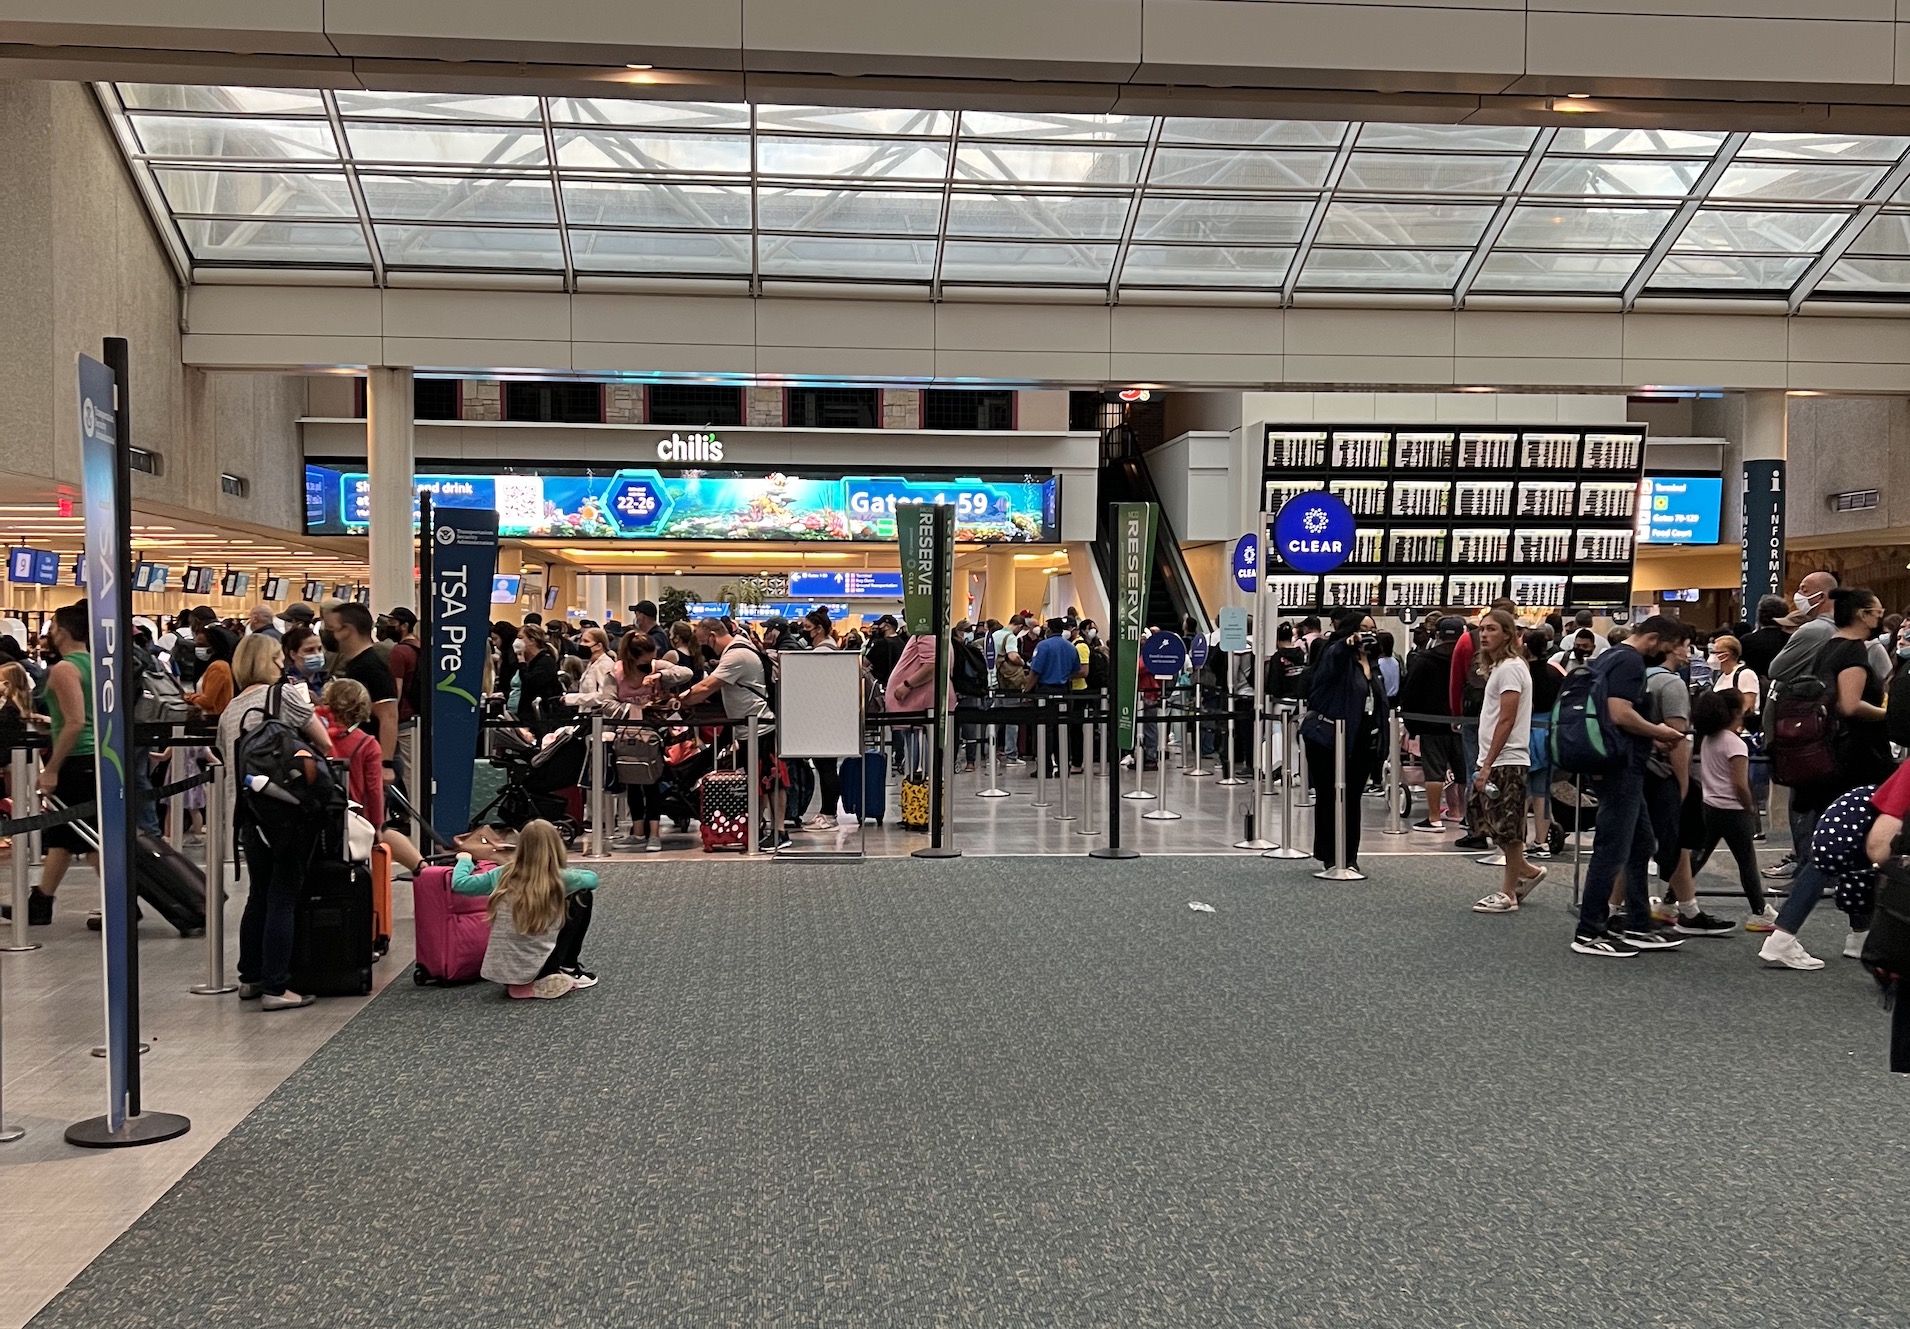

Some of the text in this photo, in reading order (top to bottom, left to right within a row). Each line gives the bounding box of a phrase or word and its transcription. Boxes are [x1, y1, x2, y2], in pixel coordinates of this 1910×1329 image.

[657, 433, 724, 461] chili's
[441, 482, 473, 494] drink
[617, 496, 656, 510] 22-26
[917, 513, 934, 595] RESERVE
[1238, 569, 1257, 579] CLEA
[1288, 540, 1343, 553] CLEAR
[1768, 503, 1780, 595] INFORMAT
[1127, 520, 1140, 641] RESERVE
[440, 565, 468, 671] TSA Pre
[100, 618, 116, 713] Pre
